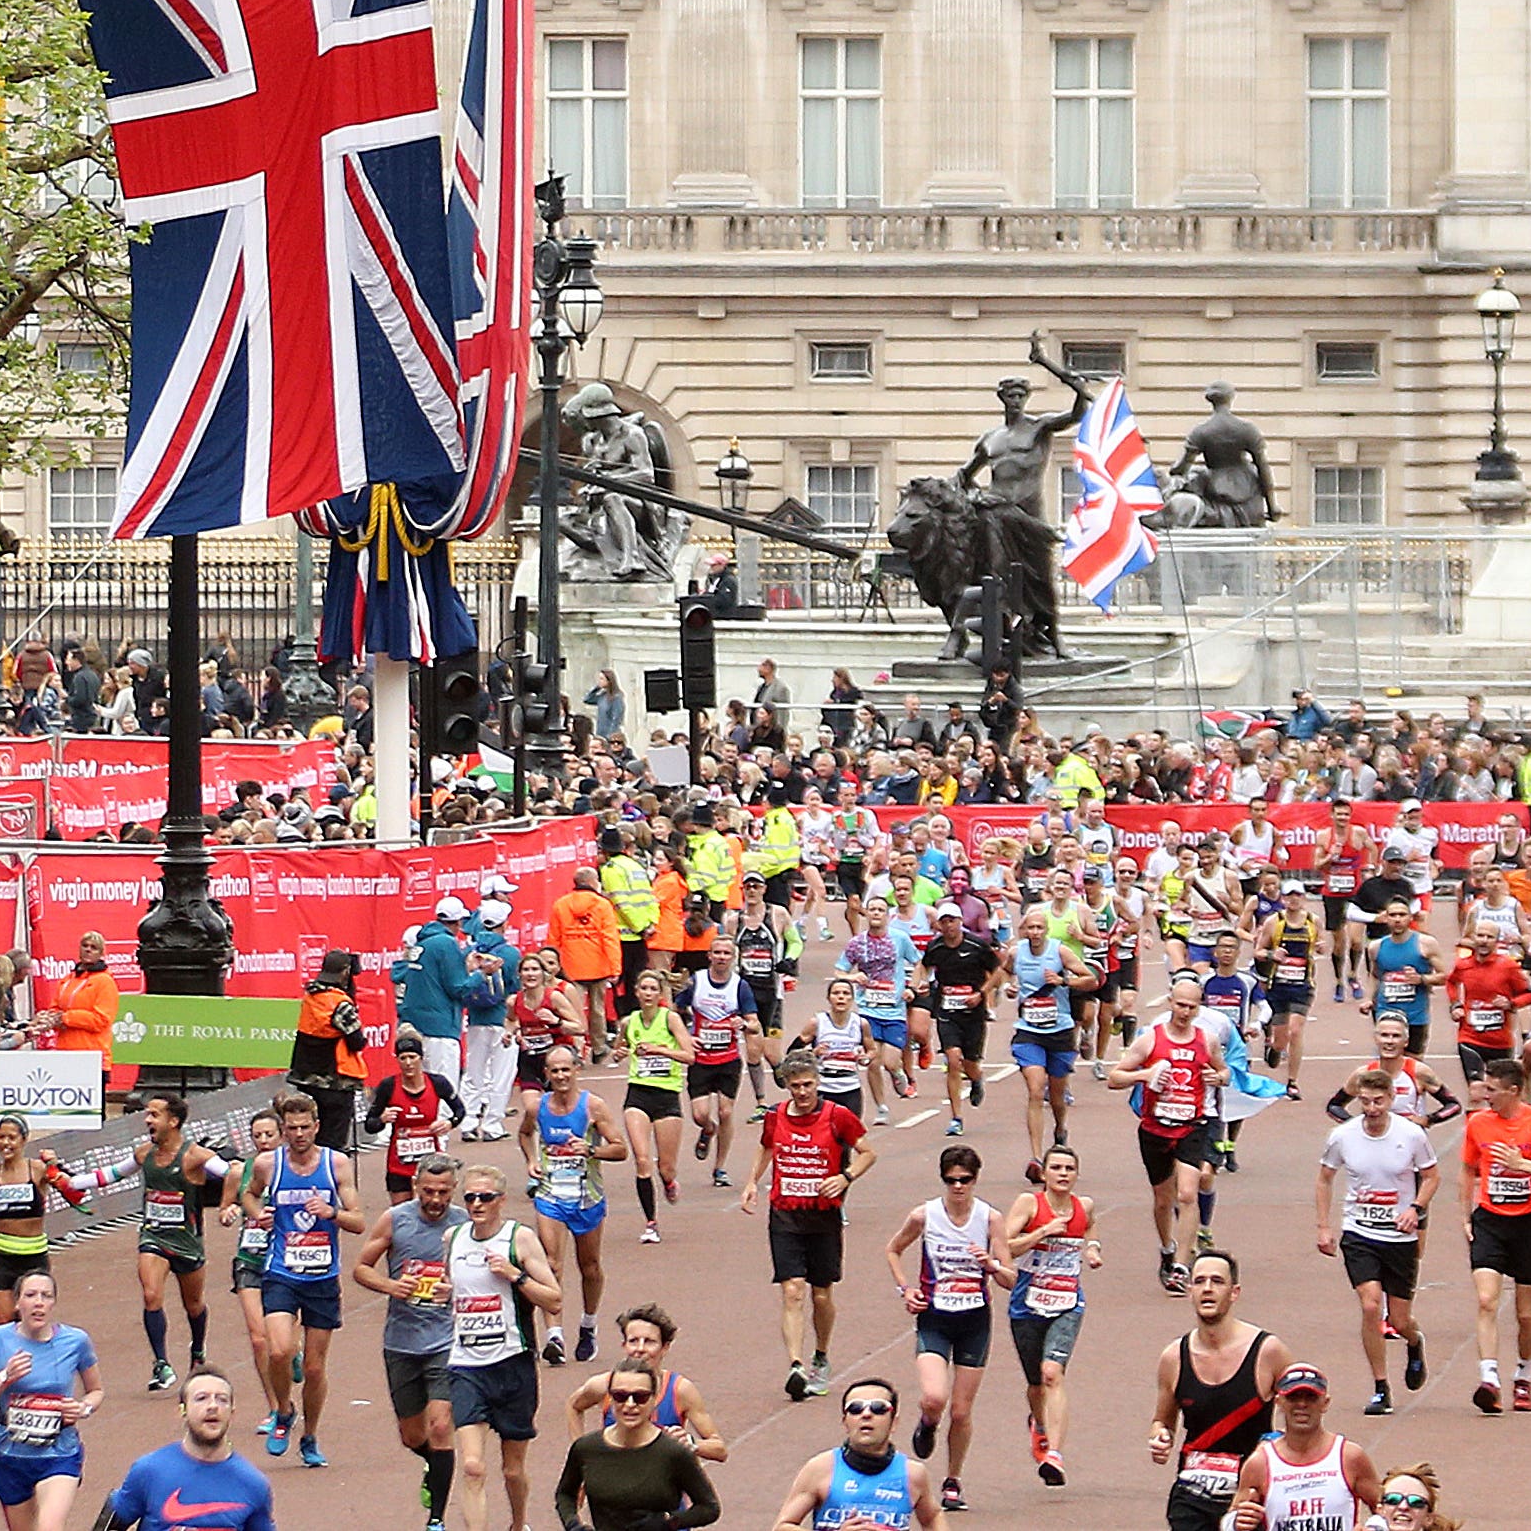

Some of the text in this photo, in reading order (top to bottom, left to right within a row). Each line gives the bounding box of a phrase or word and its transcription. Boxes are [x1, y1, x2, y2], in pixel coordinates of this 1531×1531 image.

[49, 875, 90, 909] virgin
[92, 881, 139, 906] money
[152, 1024, 185, 1038] THE
[191, 1025, 245, 1040] ROYAL
[1, 1086, 93, 1107] BUXTON
[1361, 1206, 1394, 1220] 1624
[461, 1314, 504, 1331] 32344
